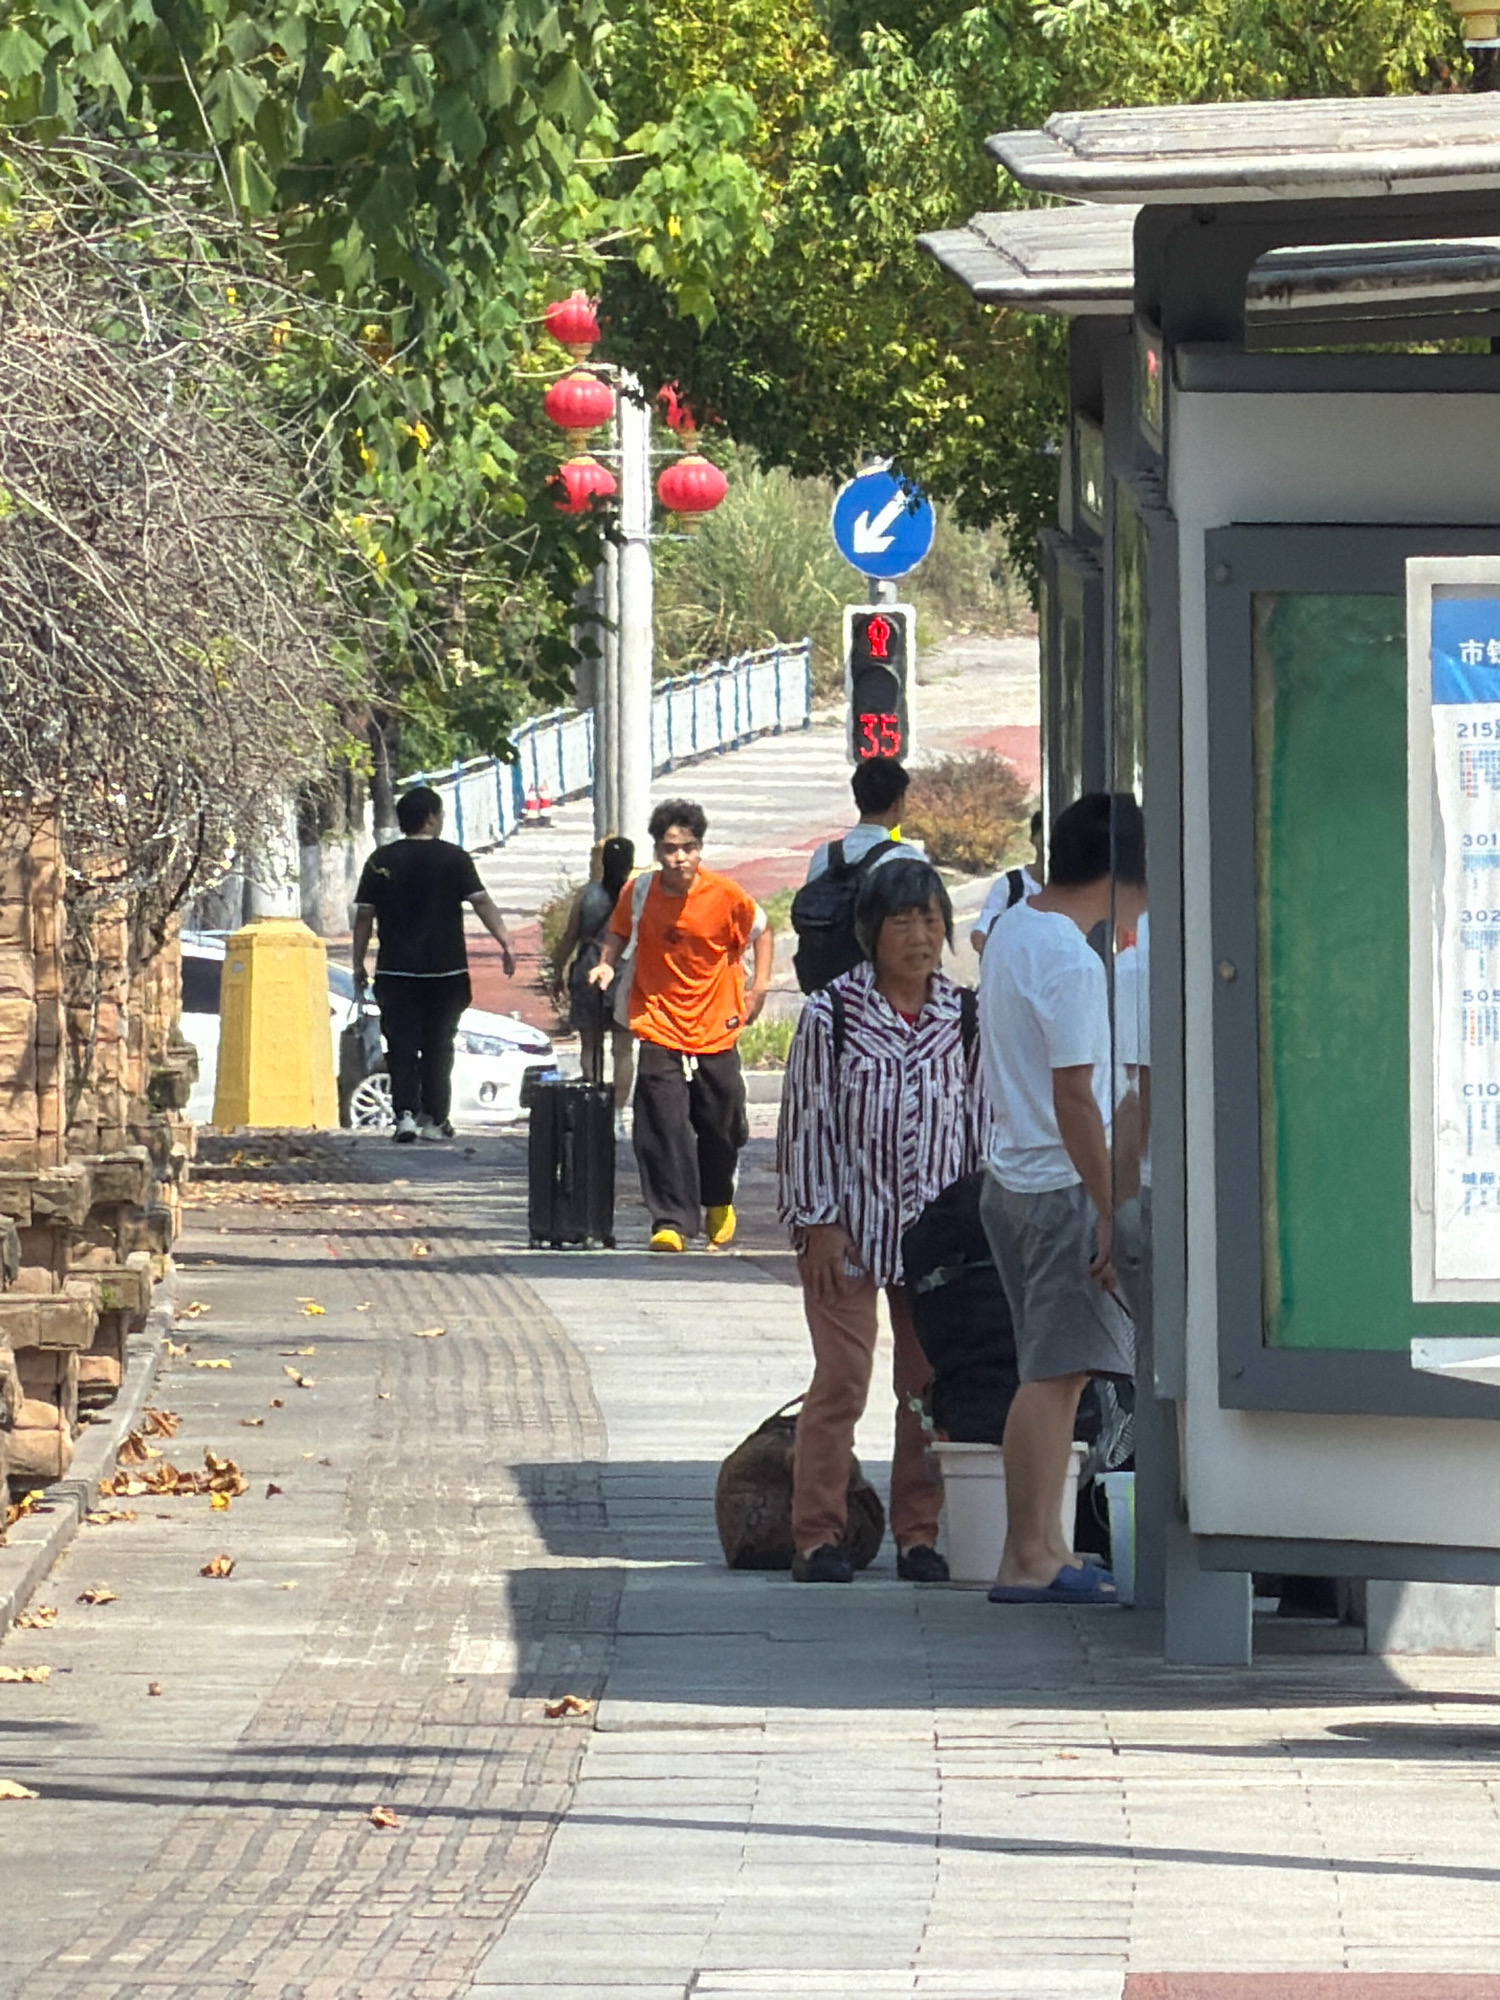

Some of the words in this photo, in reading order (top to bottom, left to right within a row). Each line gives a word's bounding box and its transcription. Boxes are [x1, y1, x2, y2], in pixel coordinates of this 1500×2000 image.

[859, 713, 901, 758] 35
[1457, 720, 1500, 738] 215
[1462, 833, 1497, 847] 301
